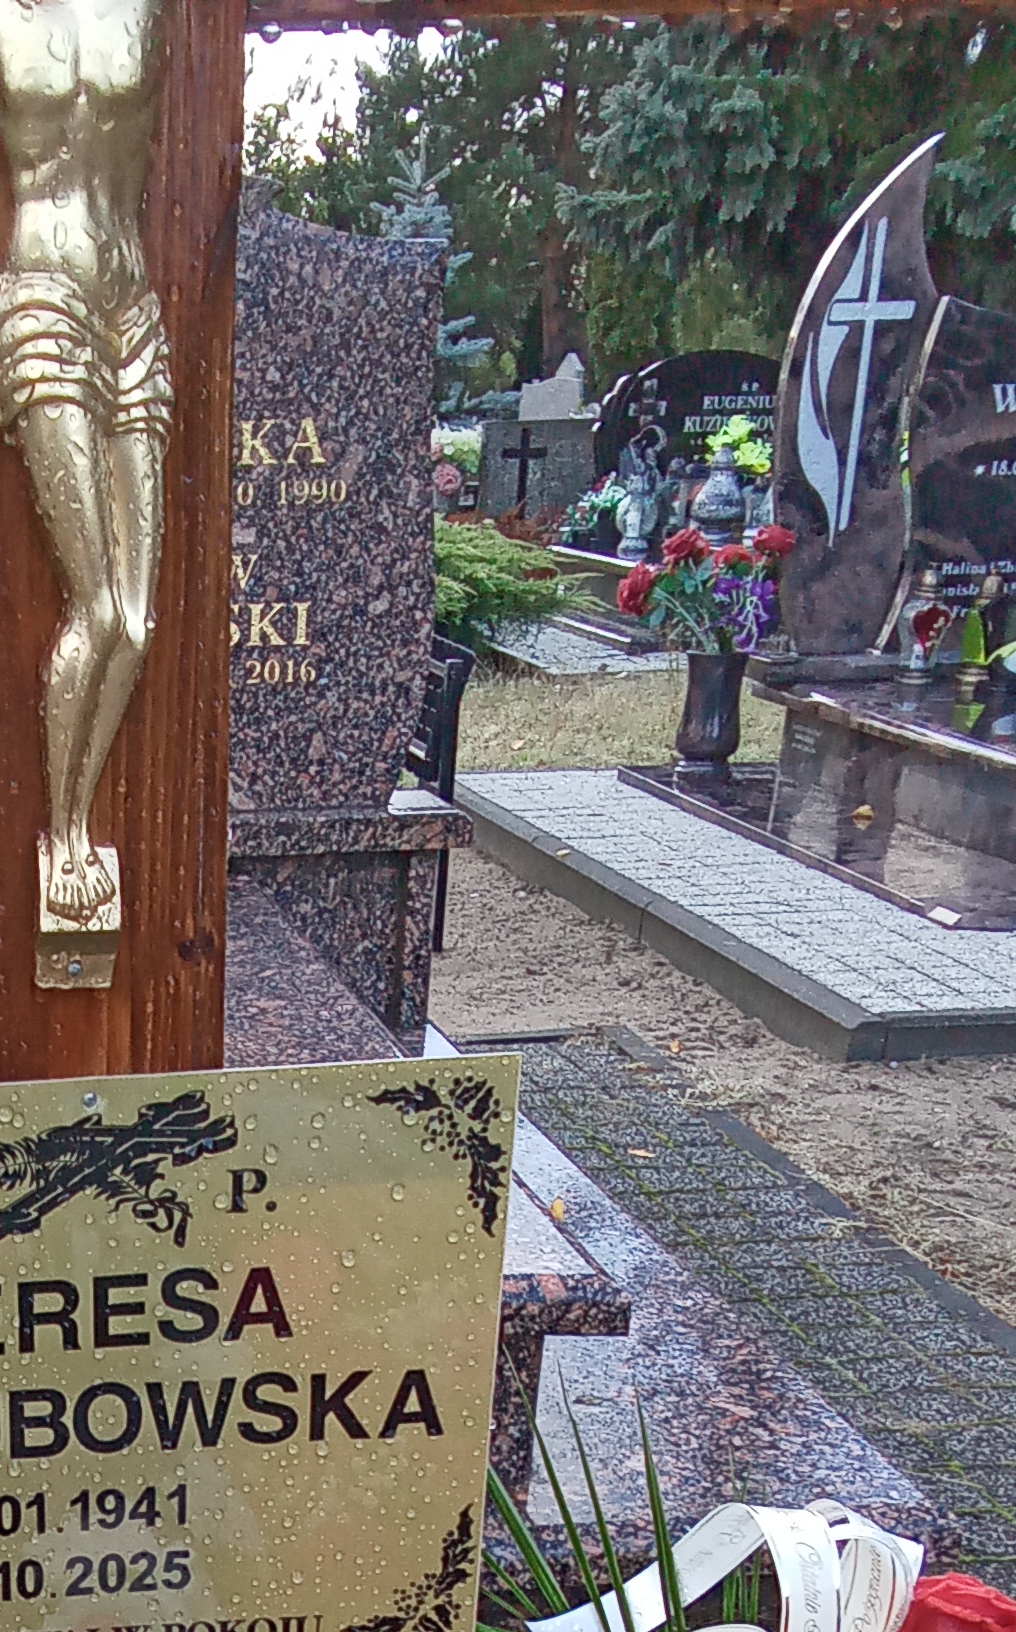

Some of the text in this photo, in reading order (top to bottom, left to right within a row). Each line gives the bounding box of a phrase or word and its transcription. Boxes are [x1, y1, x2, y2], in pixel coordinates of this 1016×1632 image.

[703, 395, 777, 409] EUGENIU
[992, 383, 1016, 414] W
[237, 416, 326, 466] KA
[279, 480, 347, 505] 1990
[246, 659, 316, 684] 2016
[226, 1167, 278, 1214] P.
